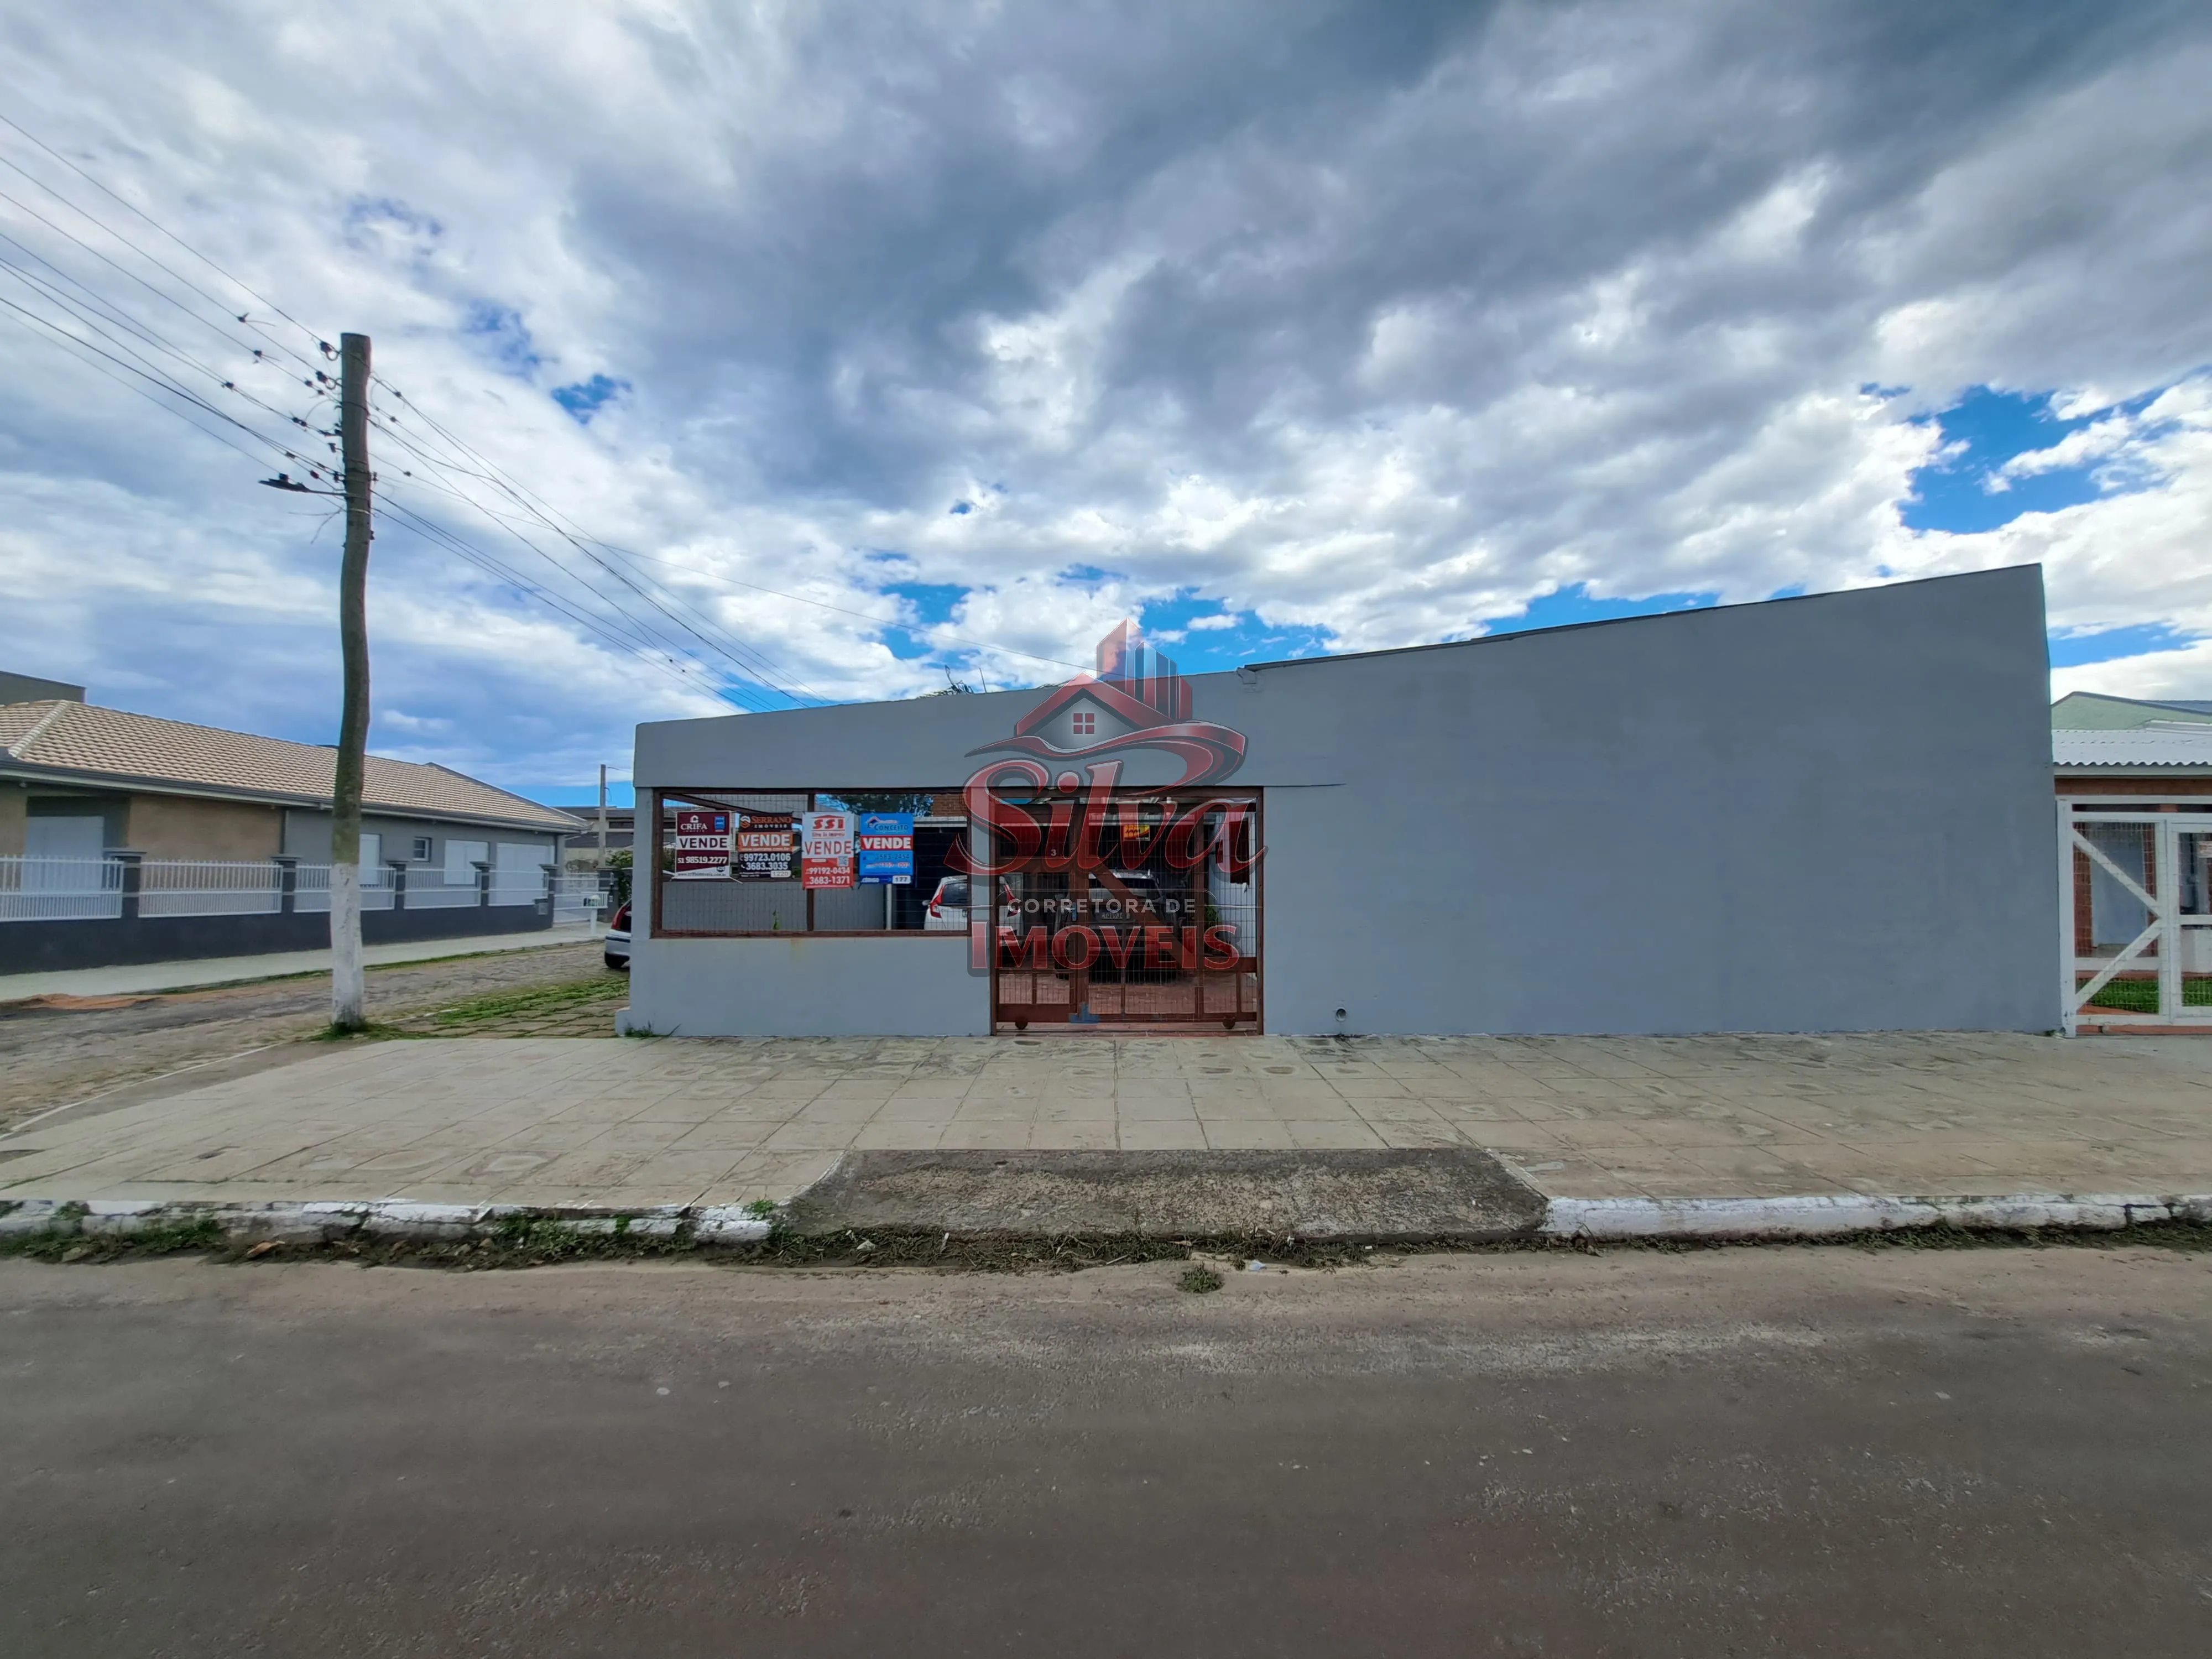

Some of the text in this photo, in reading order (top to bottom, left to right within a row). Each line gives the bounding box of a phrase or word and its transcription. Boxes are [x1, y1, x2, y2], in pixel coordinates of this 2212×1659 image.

[812, 819, 844, 829] SSI
[679, 837, 728, 848] VENDE
[741, 834, 790, 847] VENDE
[863, 837, 911, 849] VENDE
[805, 841, 852, 855] VENDE
[744, 853, 791, 862] 99723.0106
[745, 862, 788, 870] 3683.3035
[809, 876, 850, 884] 3683-1371
